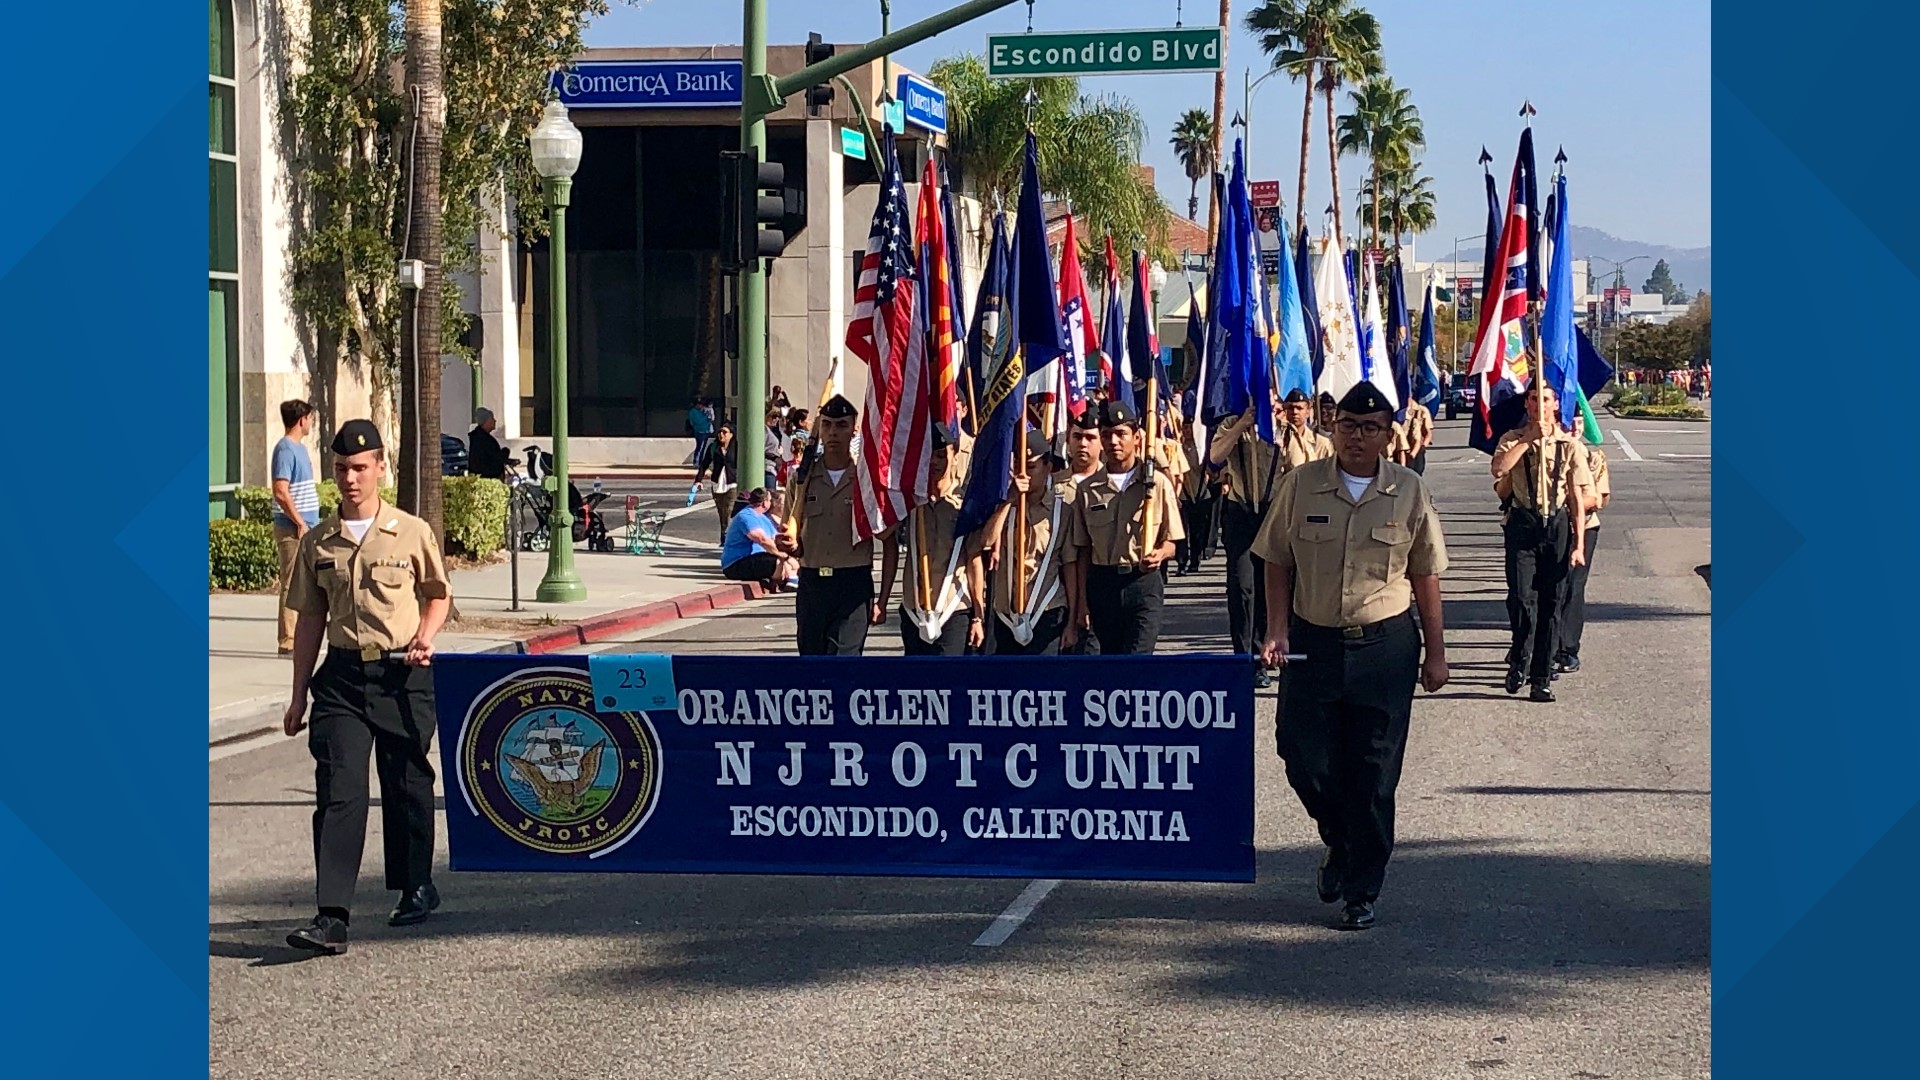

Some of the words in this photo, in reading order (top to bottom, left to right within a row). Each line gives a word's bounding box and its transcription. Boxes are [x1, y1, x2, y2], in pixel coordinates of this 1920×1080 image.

[992, 41, 1142, 67] Escondido
[1152, 38, 1218, 62] Blvd
[676, 70, 735, 92] Bank
[616, 668, 648, 689] 23
[517, 689, 594, 708] NAVY
[677, 688, 834, 727] ORANGE
[849, 688, 952, 726] GLEN
[967, 689, 1068, 727] HIGH
[1083, 690, 1237, 729] SCHOOL
[1060, 743, 1201, 790] UNIT
[518, 817, 609, 841] JROTC
[729, 805, 948, 843] ESCONDIDO,
[962, 807, 1191, 842] CALIFORNIA
